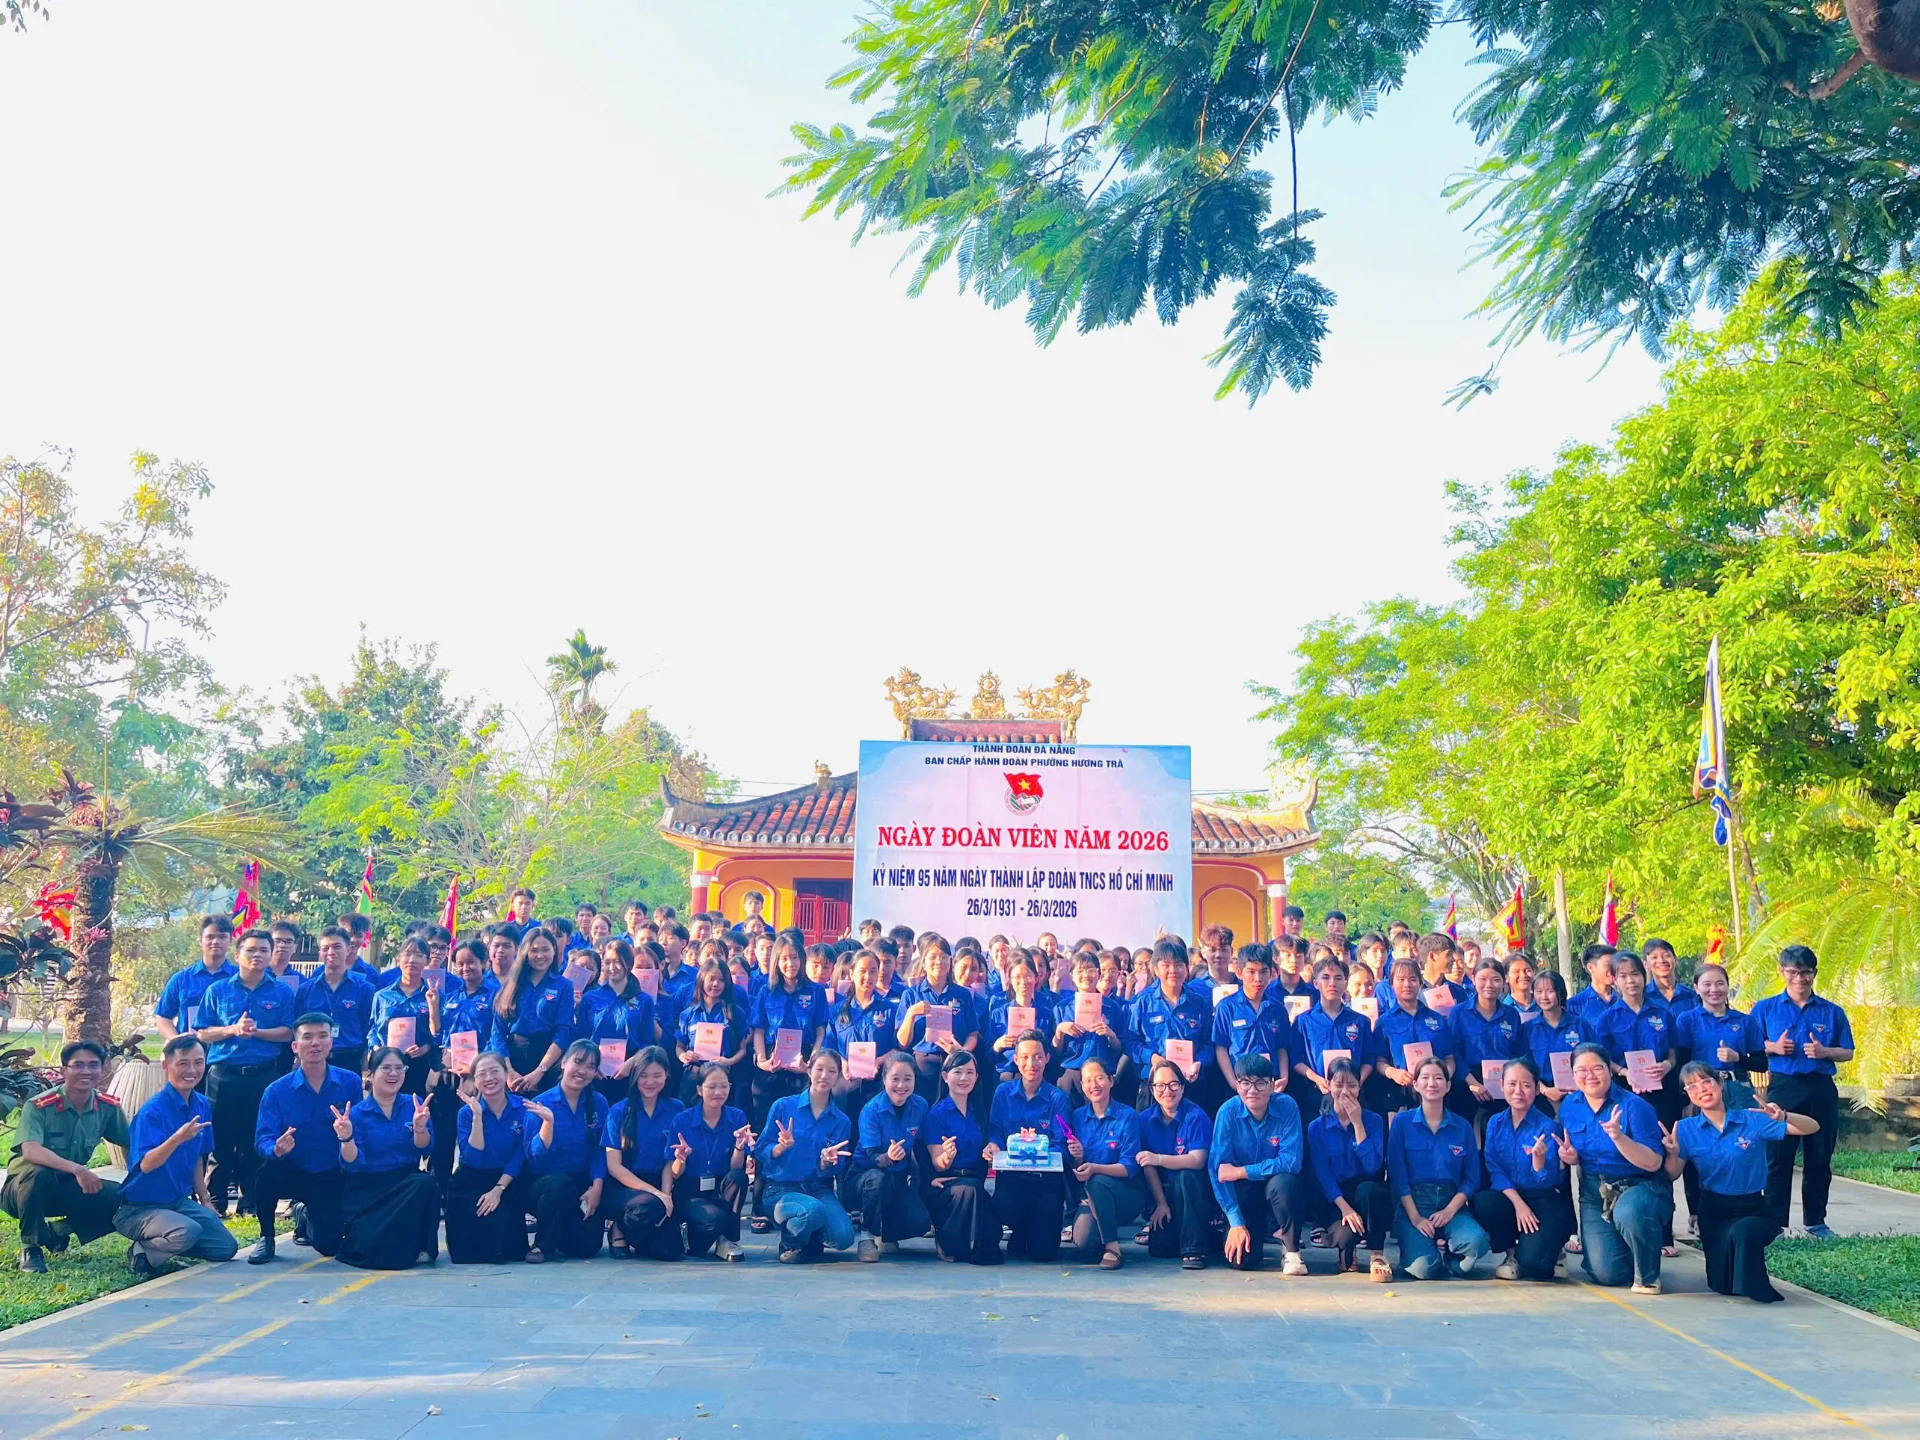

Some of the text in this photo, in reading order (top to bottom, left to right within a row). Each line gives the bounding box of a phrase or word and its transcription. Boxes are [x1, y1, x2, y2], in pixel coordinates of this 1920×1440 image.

[925, 757, 944, 765] BAN
[974, 756, 1000, 766] HÀNH
[1002, 757, 1028, 766] ĐOÀN
[878, 820, 1169, 851] NGÀY ĐOÀN VIÊN NĂM 2026
[873, 862, 1173, 893] KỶ NIỆM 95 NĂM NGÀY THÀNH LẬP ĐOÀN TNCS HỒ CHÍ MINH
[967, 898, 1016, 917] 26/3/1931
[1027, 899, 1077, 918] 26/3/2026
